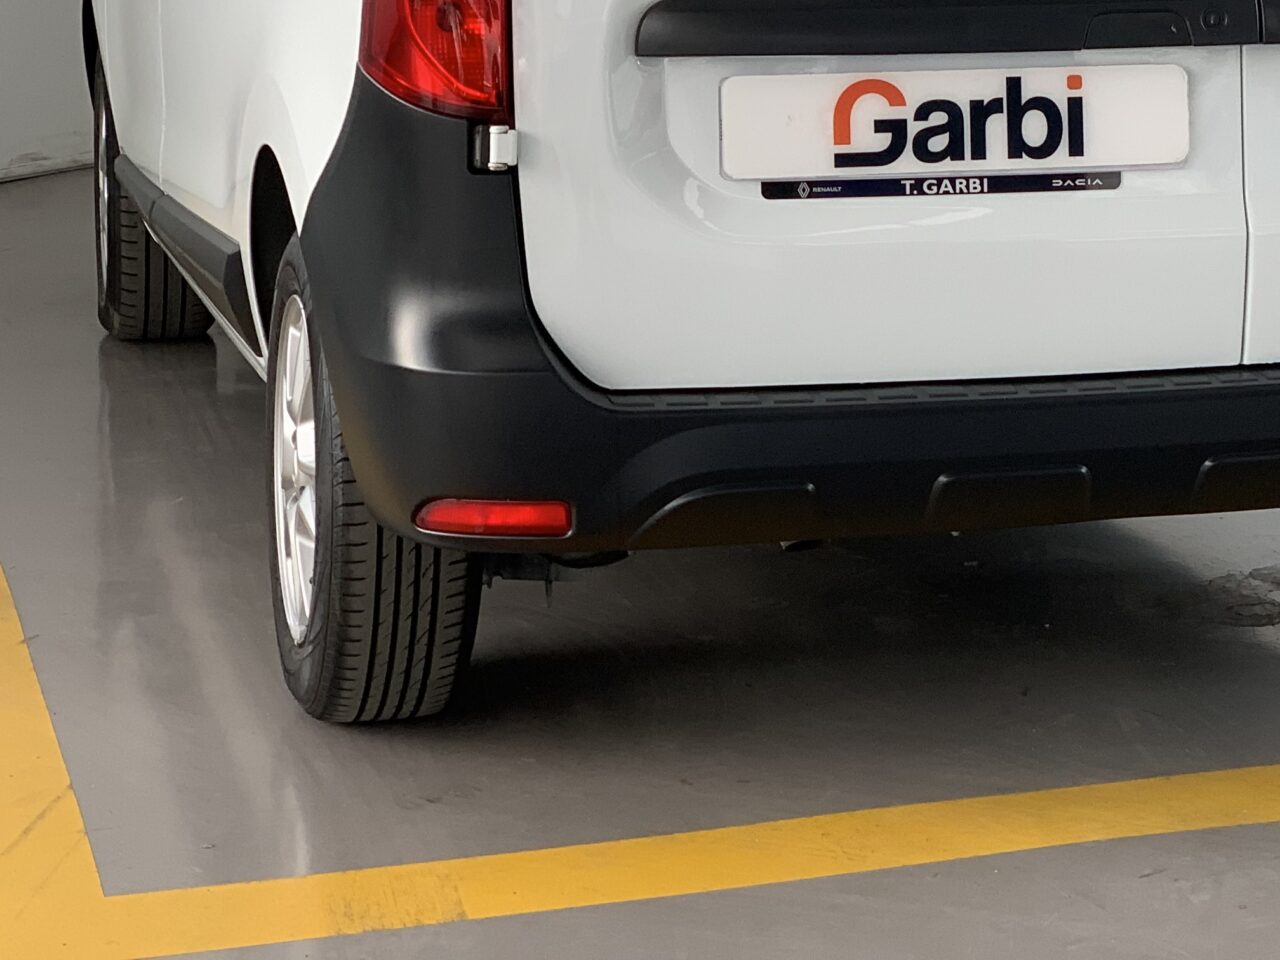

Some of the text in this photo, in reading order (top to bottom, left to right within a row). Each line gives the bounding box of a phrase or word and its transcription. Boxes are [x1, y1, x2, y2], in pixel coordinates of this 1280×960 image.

[832, 74, 1085, 169] Garbi
[901, 177, 989, 195] T. GARBI
[1051, 178, 1104, 187] DACIA
